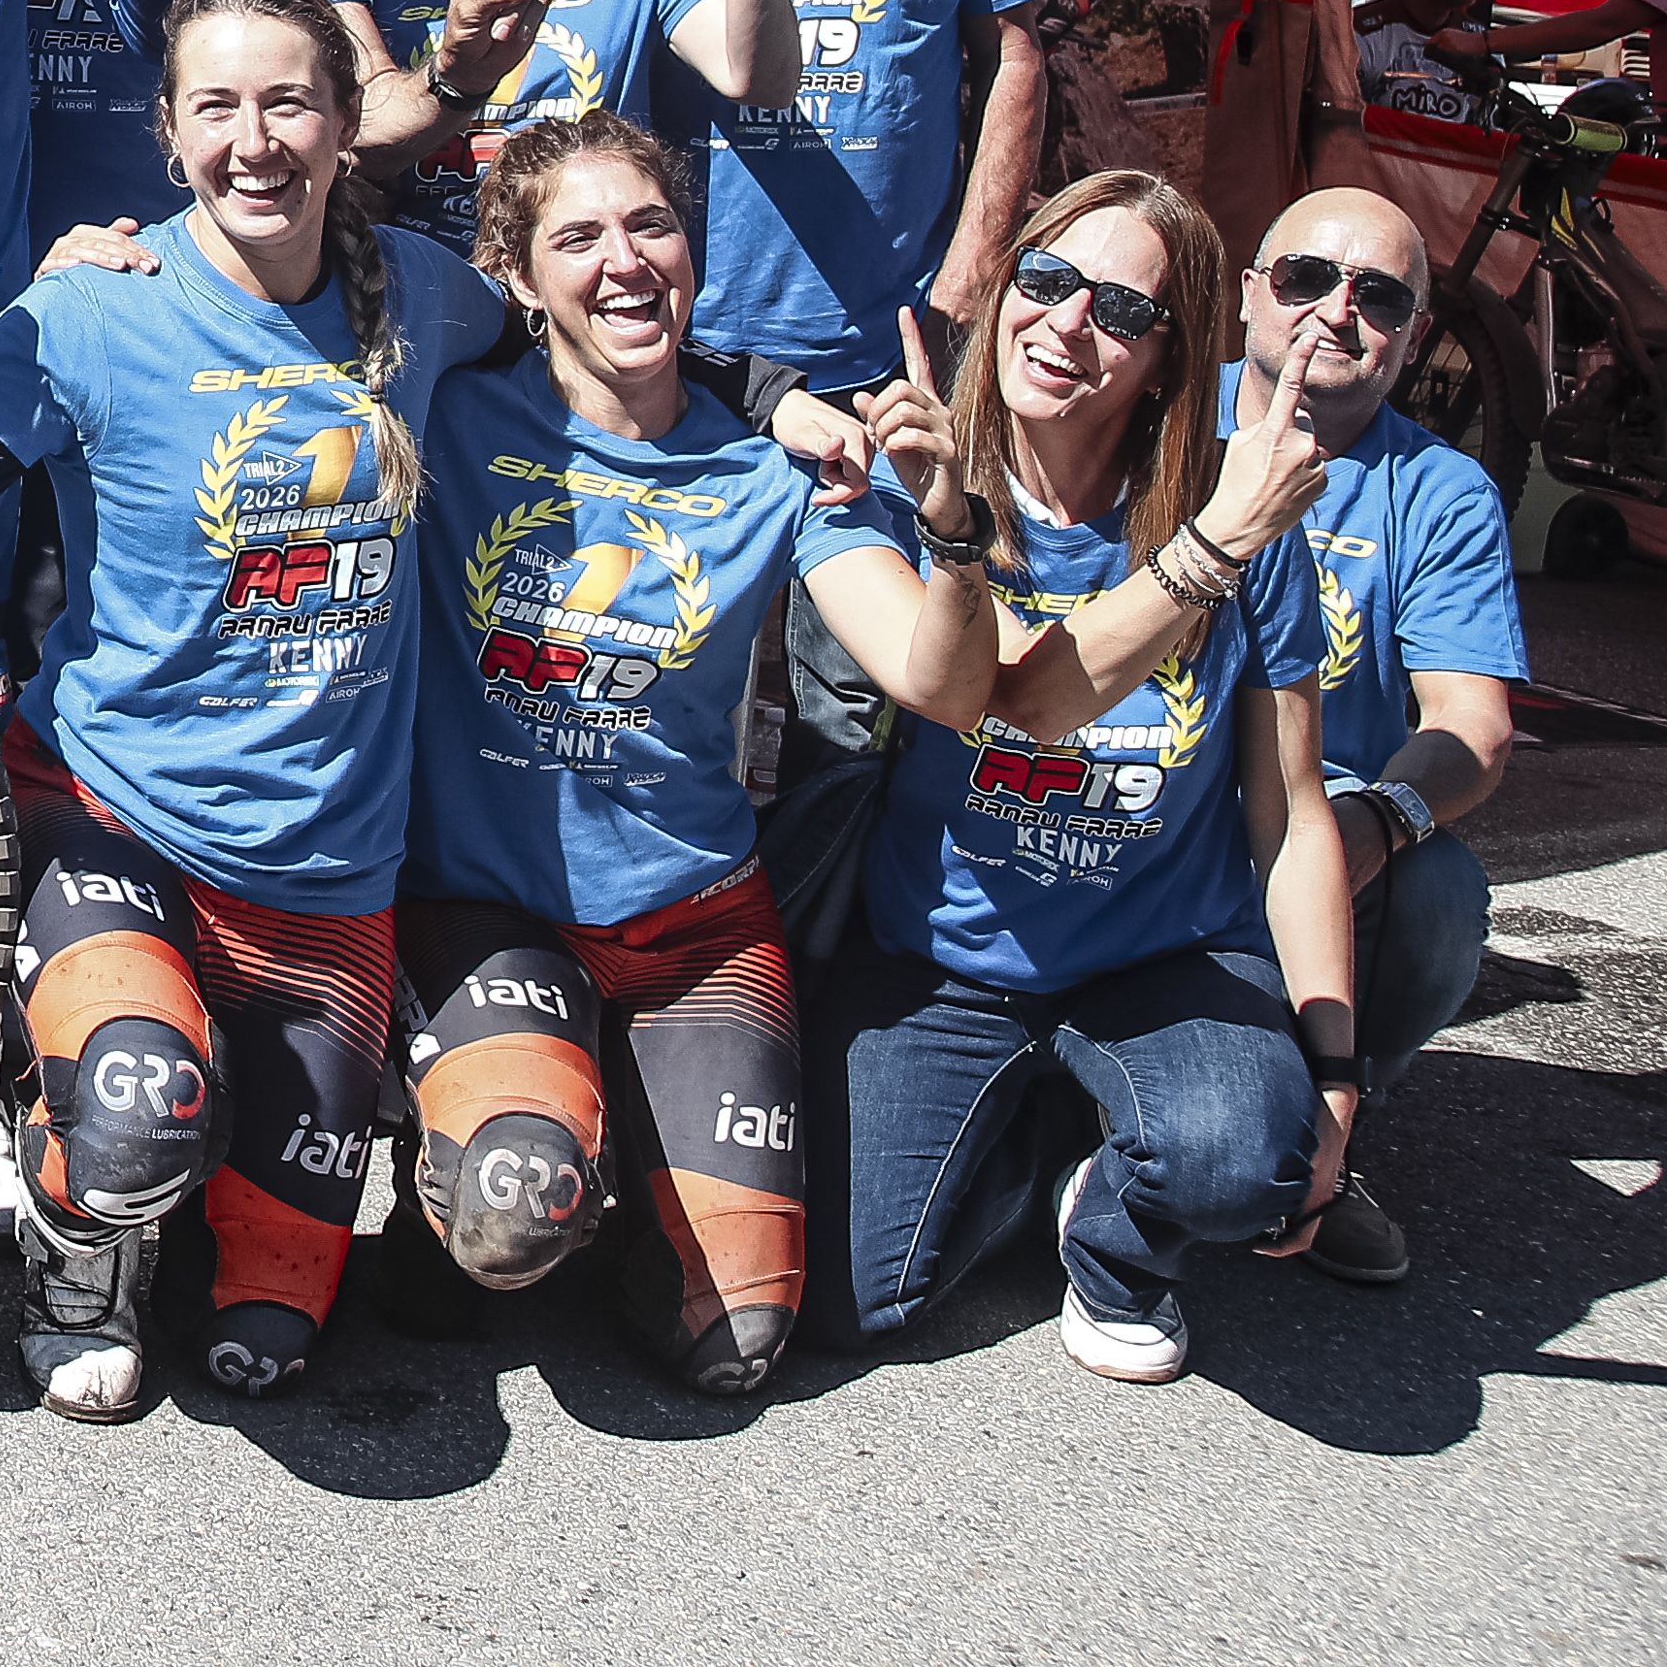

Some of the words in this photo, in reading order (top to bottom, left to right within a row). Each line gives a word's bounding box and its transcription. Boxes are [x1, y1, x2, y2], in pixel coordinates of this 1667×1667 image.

[799, 18, 862, 69] 19
[30, 55, 93, 83] NNY
[189, 361, 369, 393] SHERC
[240, 485, 301, 510] 2026
[488, 454, 726, 518] SHERCO
[501, 572, 565, 602] 2026
[492, 596, 679, 650] CHAMPION
[268, 635, 366, 673] KENNY
[517, 719, 618, 759] ENNY
[1017, 826, 1122, 868] KENNY
[55, 871, 165, 922] iati
[465, 975, 568, 1021] iati
[714, 1092, 796, 1151] iati
